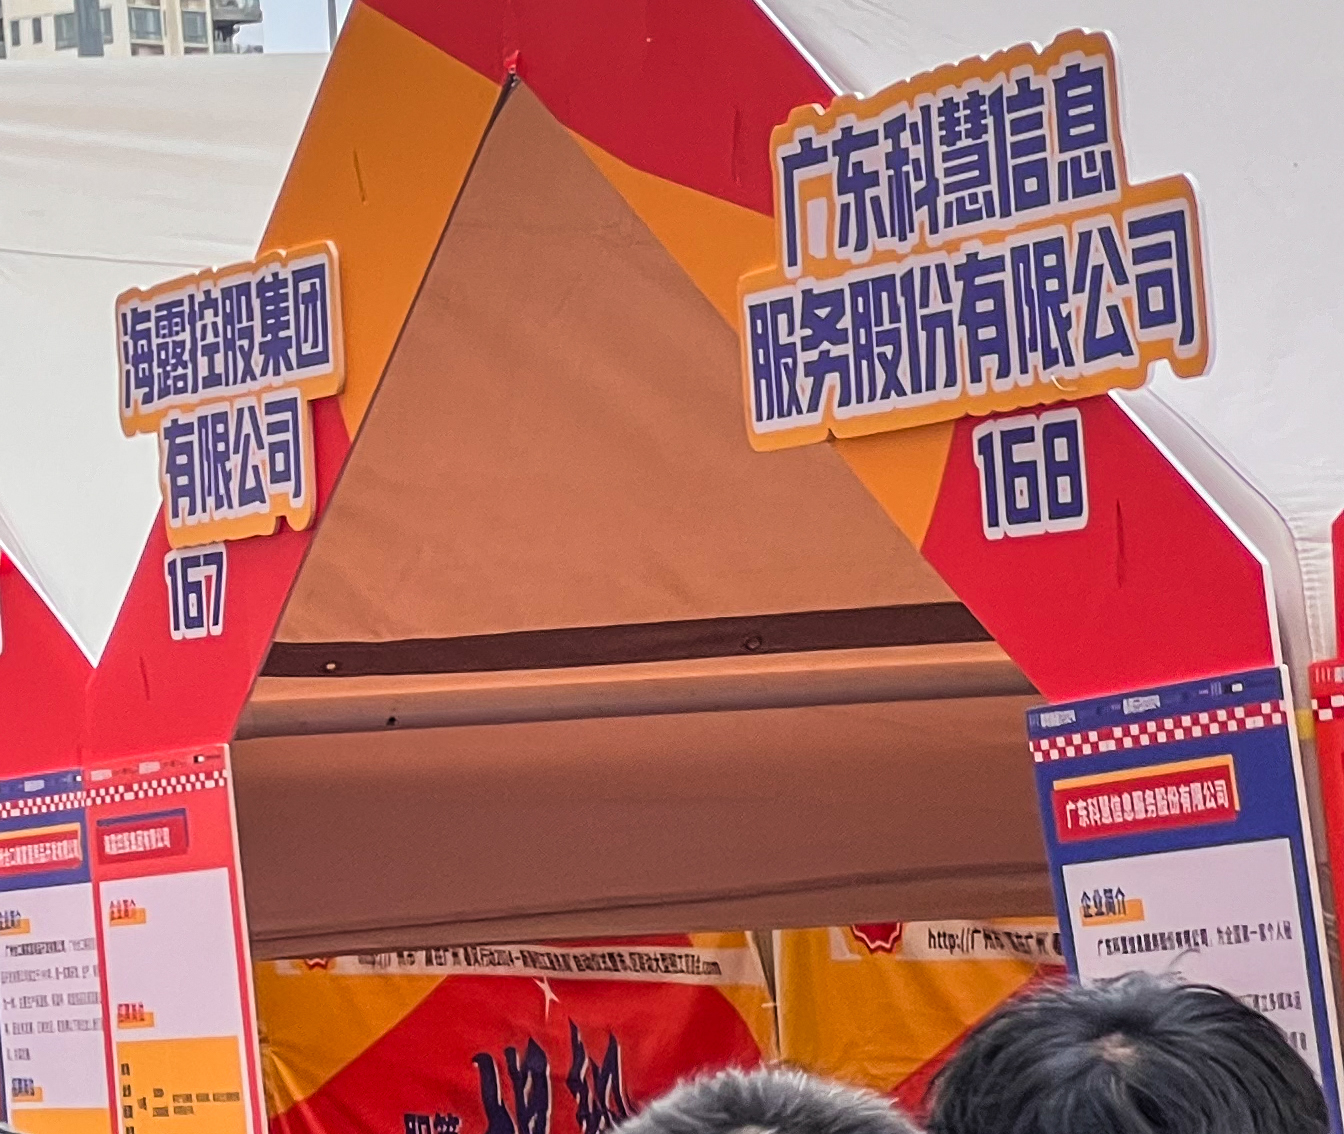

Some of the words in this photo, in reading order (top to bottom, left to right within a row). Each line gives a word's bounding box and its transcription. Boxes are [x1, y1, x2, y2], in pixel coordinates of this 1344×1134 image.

[782, 64, 1115, 268] 广东科慧信息
[120, 262, 330, 416] 海露控股集团
[749, 209, 1195, 423] 服务股份有限公司
[163, 397, 303, 521] 有限公司
[977, 418, 1084, 528] 168
[168, 553, 224, 633] 167
